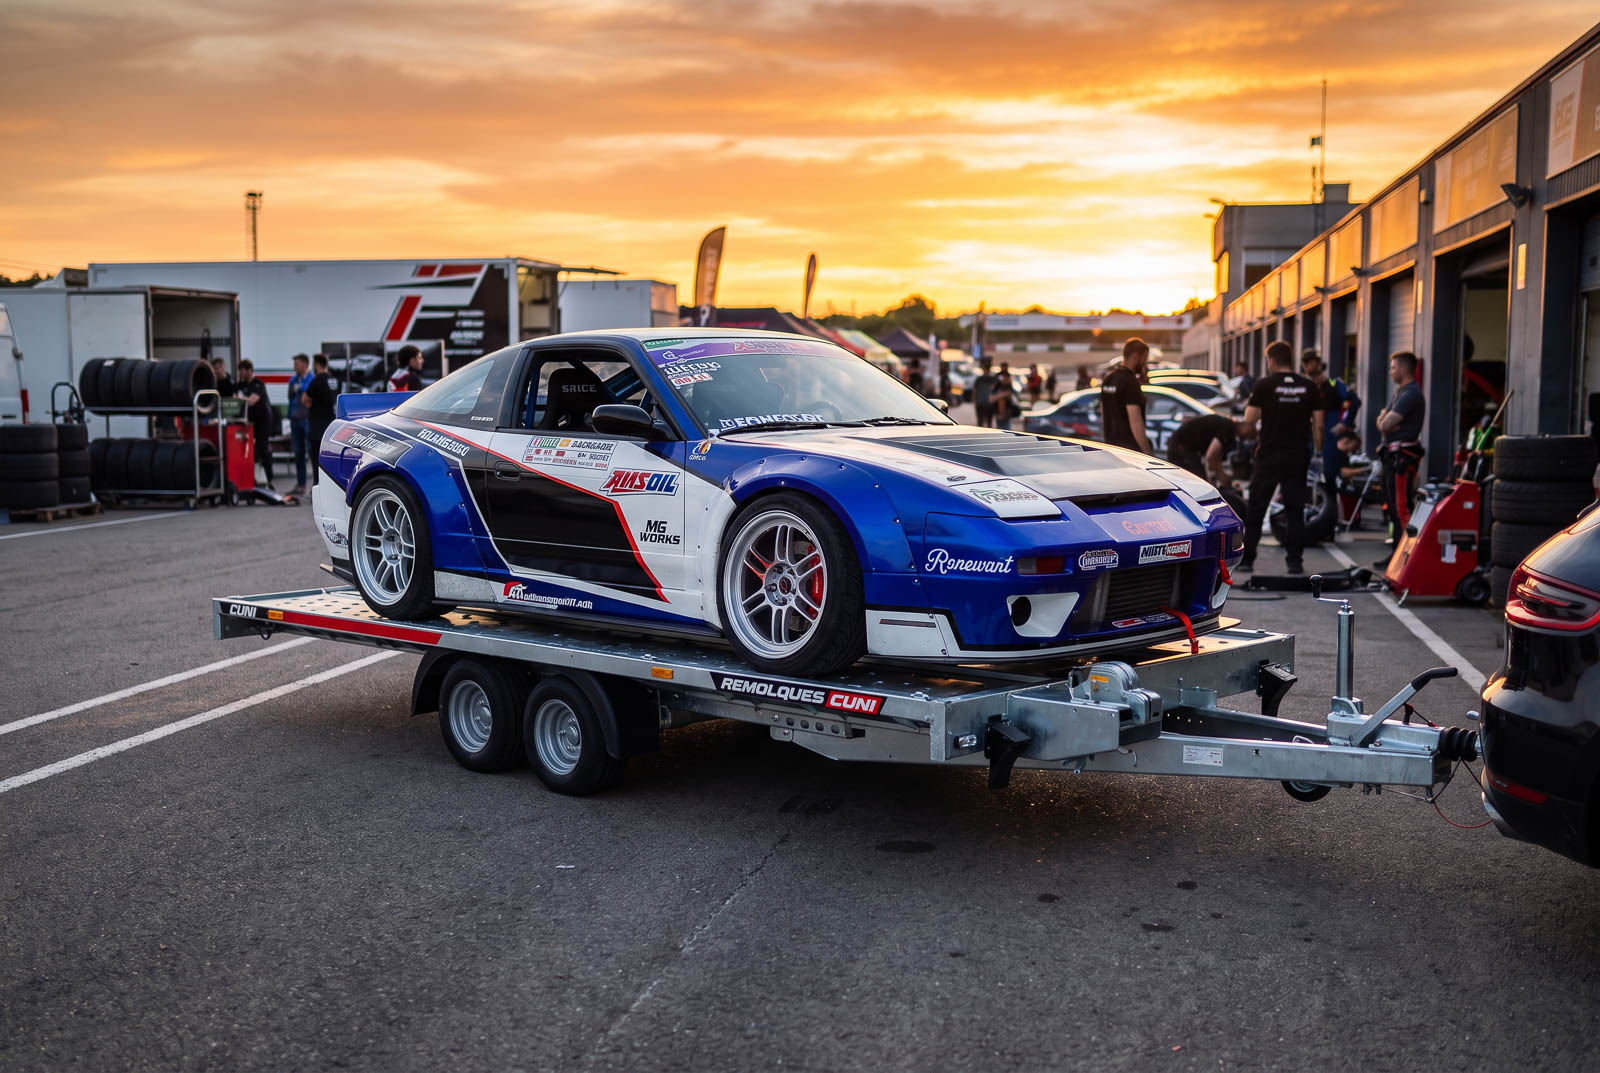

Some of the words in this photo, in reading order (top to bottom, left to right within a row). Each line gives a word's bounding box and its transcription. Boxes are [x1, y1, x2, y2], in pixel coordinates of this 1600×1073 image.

[645, 519, 667, 533] MG
[640, 532, 680, 545] WORKS
[230, 603, 257, 618] CUNI
[720, 677, 826, 704] REMOLQUES
[829, 694, 877, 712] CUNI
